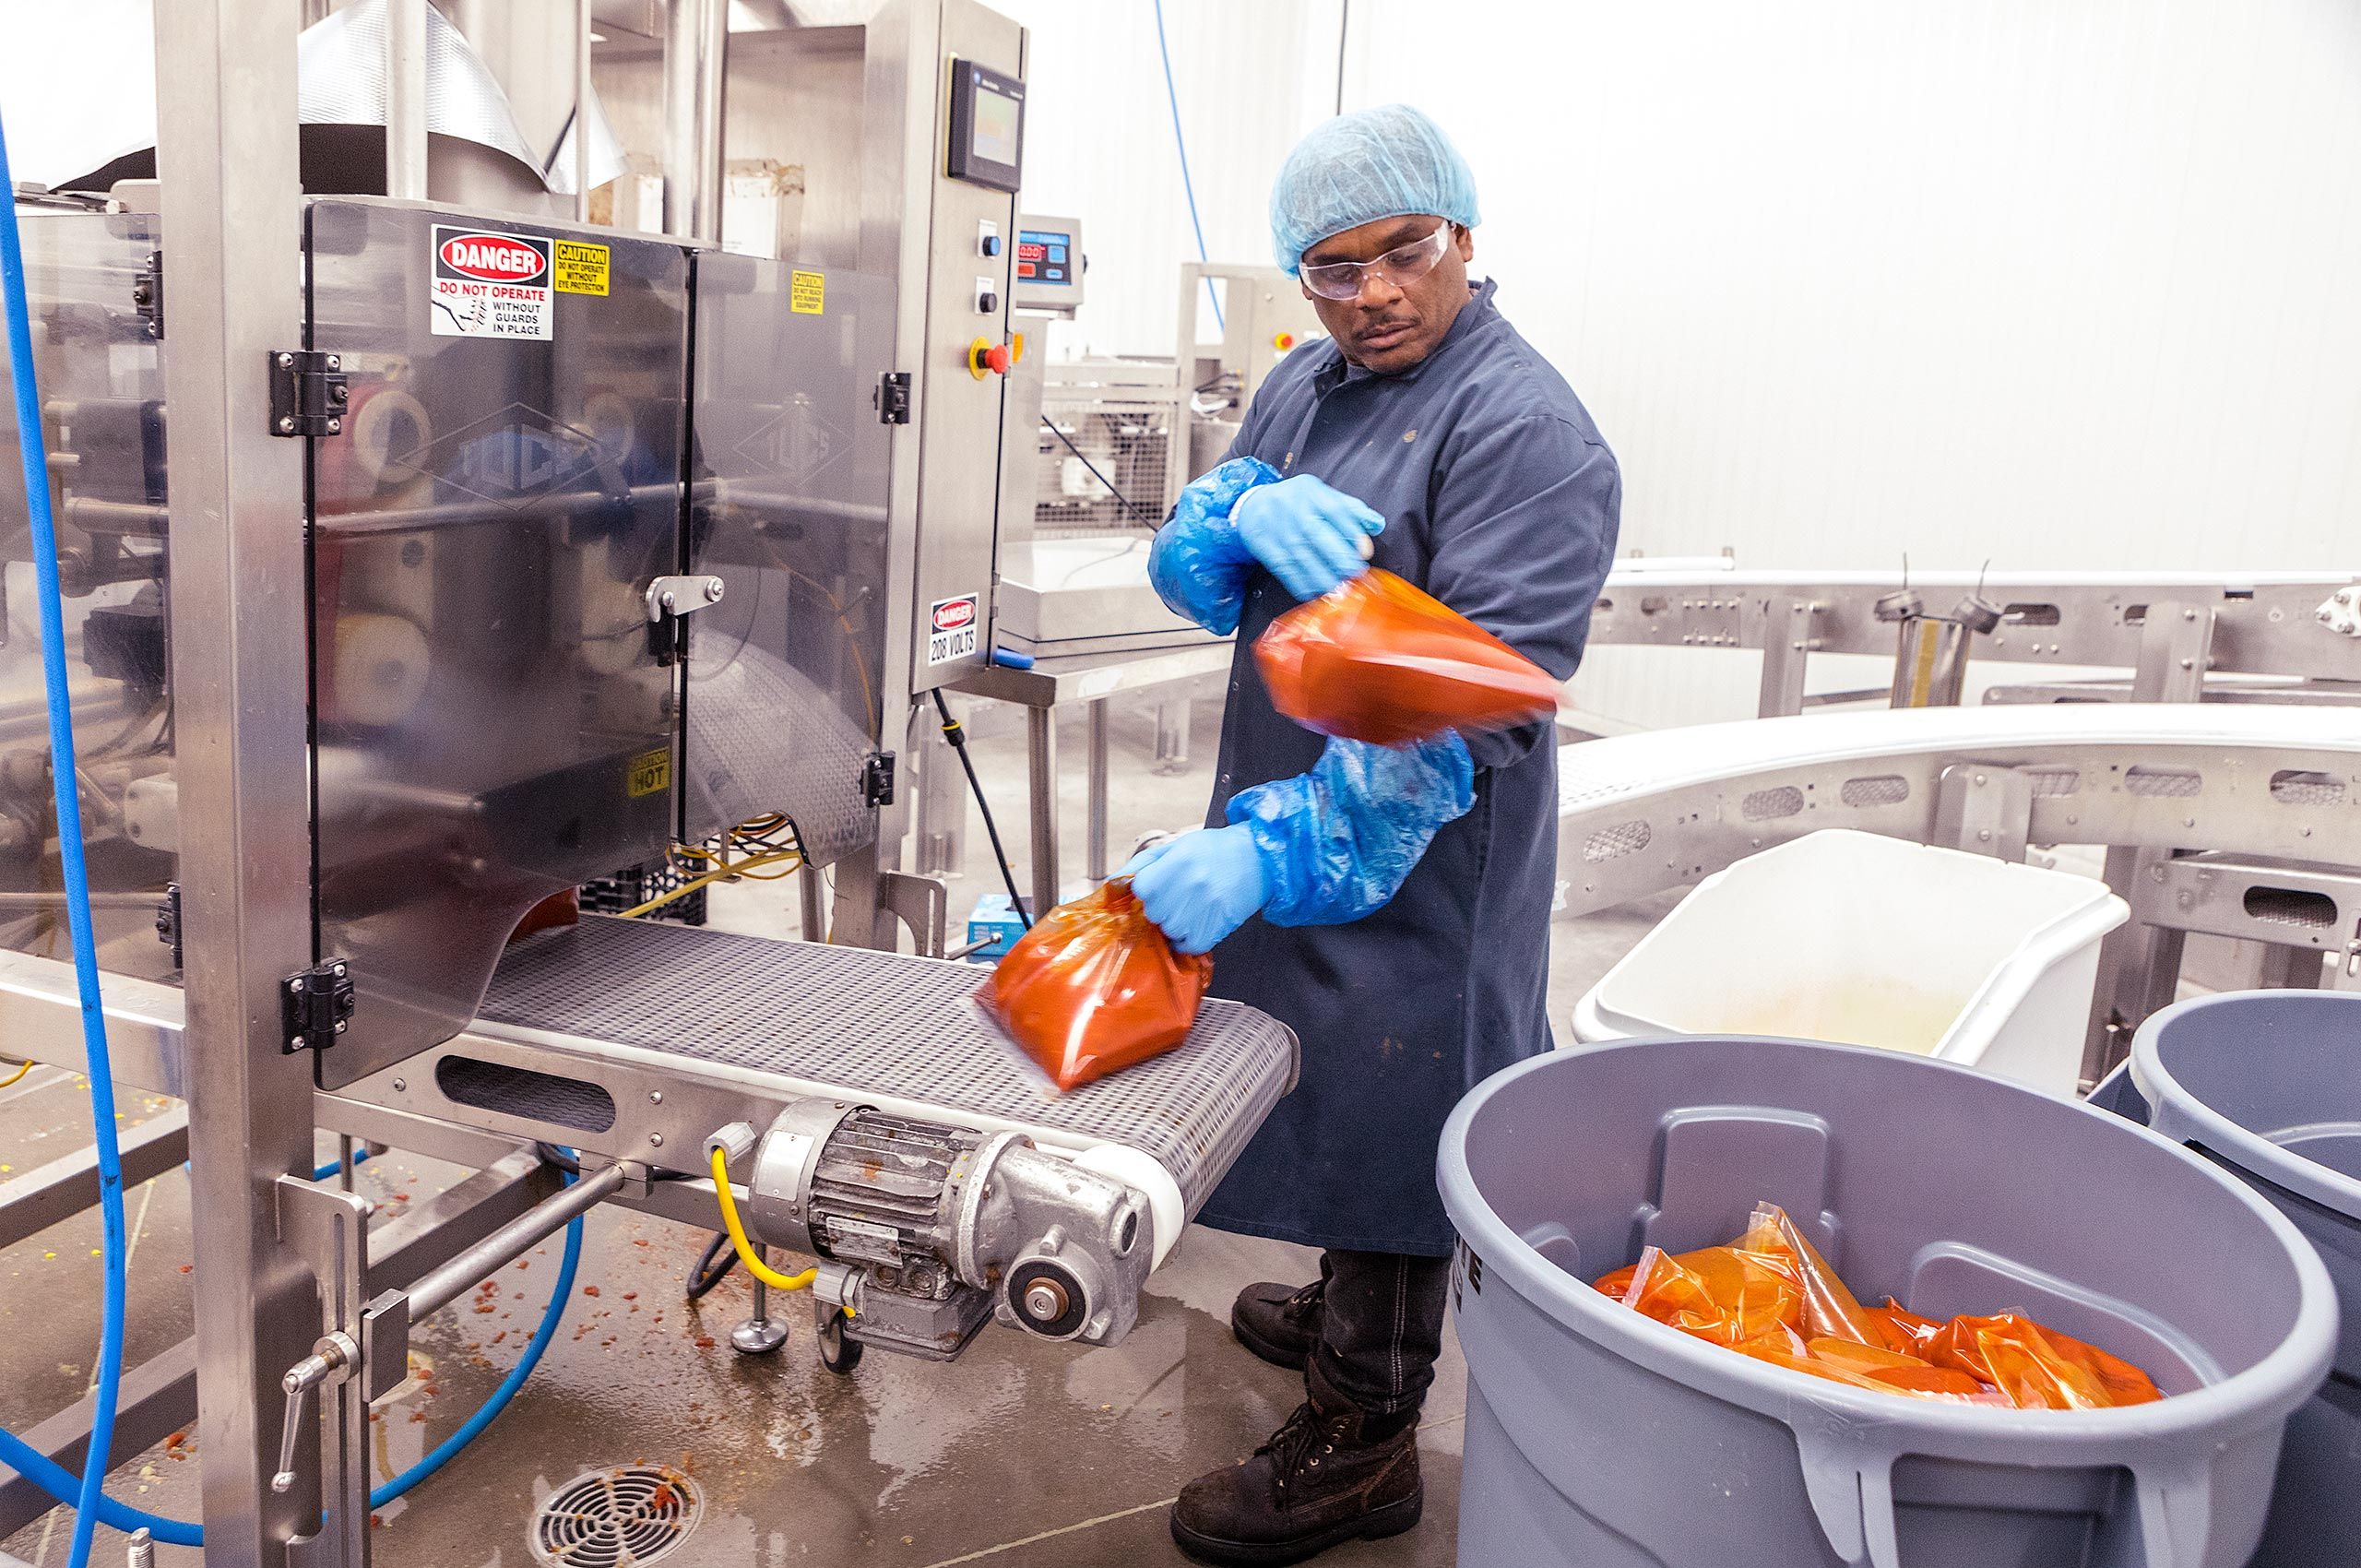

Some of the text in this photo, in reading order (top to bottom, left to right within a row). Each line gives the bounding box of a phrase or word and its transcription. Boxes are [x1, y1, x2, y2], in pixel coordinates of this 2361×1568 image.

[451, 242, 537, 274] DANGER
[559, 244, 605, 264] CAUTION
[558, 261, 605, 274] DO NOT OPERATE
[566, 272, 597, 282] WITHOUT
[440, 281, 545, 302] DO NOT OPERATE
[558, 279, 569, 289] EYE
[571, 280, 605, 292] PROTECTION
[492, 301, 541, 314] WITHOUT
[495, 312, 539, 324] GUARDS
[493, 323, 504, 333] IN
[506, 324, 540, 336] PLACE
[937, 604, 972, 625] DANGER
[931, 630, 974, 661] 208 VOLTS
[634, 766, 664, 792] HOT
